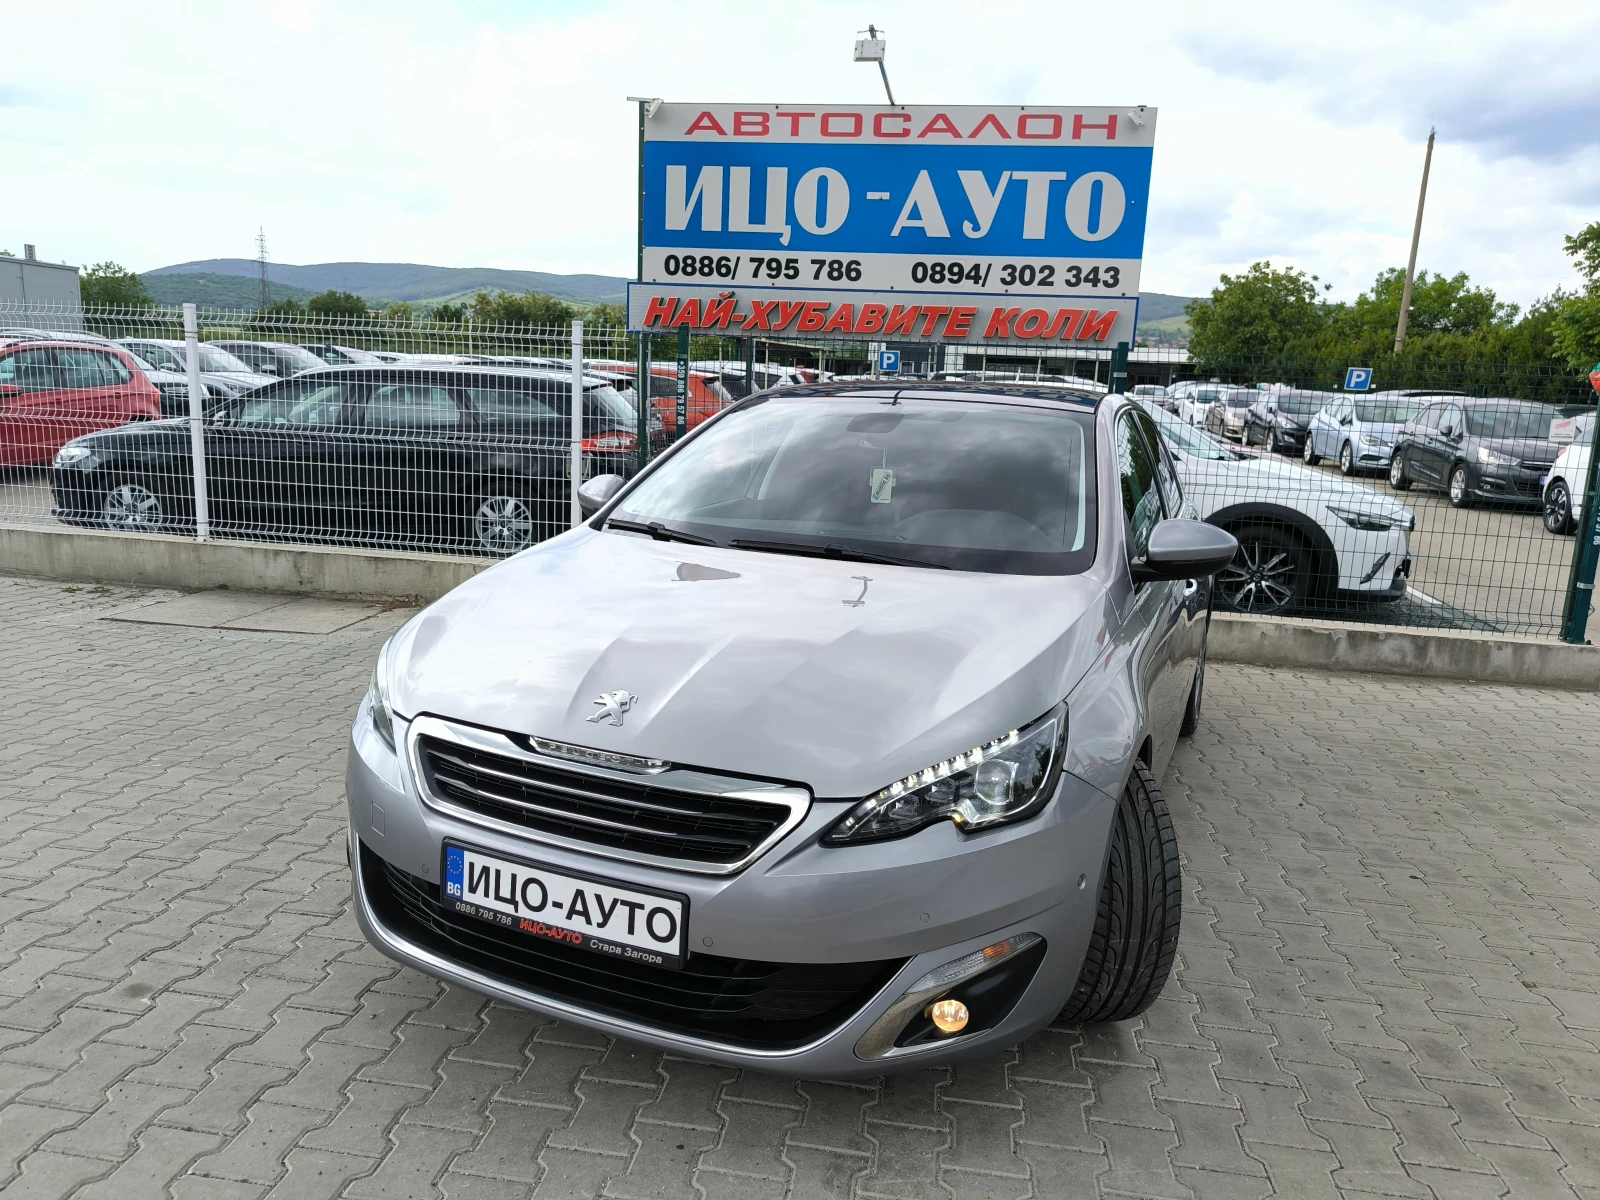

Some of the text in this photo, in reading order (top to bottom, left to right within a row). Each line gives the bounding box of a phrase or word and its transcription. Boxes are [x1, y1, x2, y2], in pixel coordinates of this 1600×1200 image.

[684, 111, 1118, 140] АВТОСАЛОН
[664, 254, 862, 282] 0886/ 795 786
[911, 261, 1120, 289] 0894/ 302 343
[643, 292, 1119, 342] НАЙ-ХУБАВИТЕ КОЛИ
[882, 353, 896, 369] P
[1350, 370, 1366, 388] P
[677, 361, 686, 425] +359 886 79 57 86
[447, 882, 461, 896] BG
[467, 861, 678, 944] ИЦО-АУТО
[455, 901, 512, 926] 0886 795 786
[519, 918, 583, 945] ИЦО-АУТО
[590, 939, 663, 965] Стара Загора
